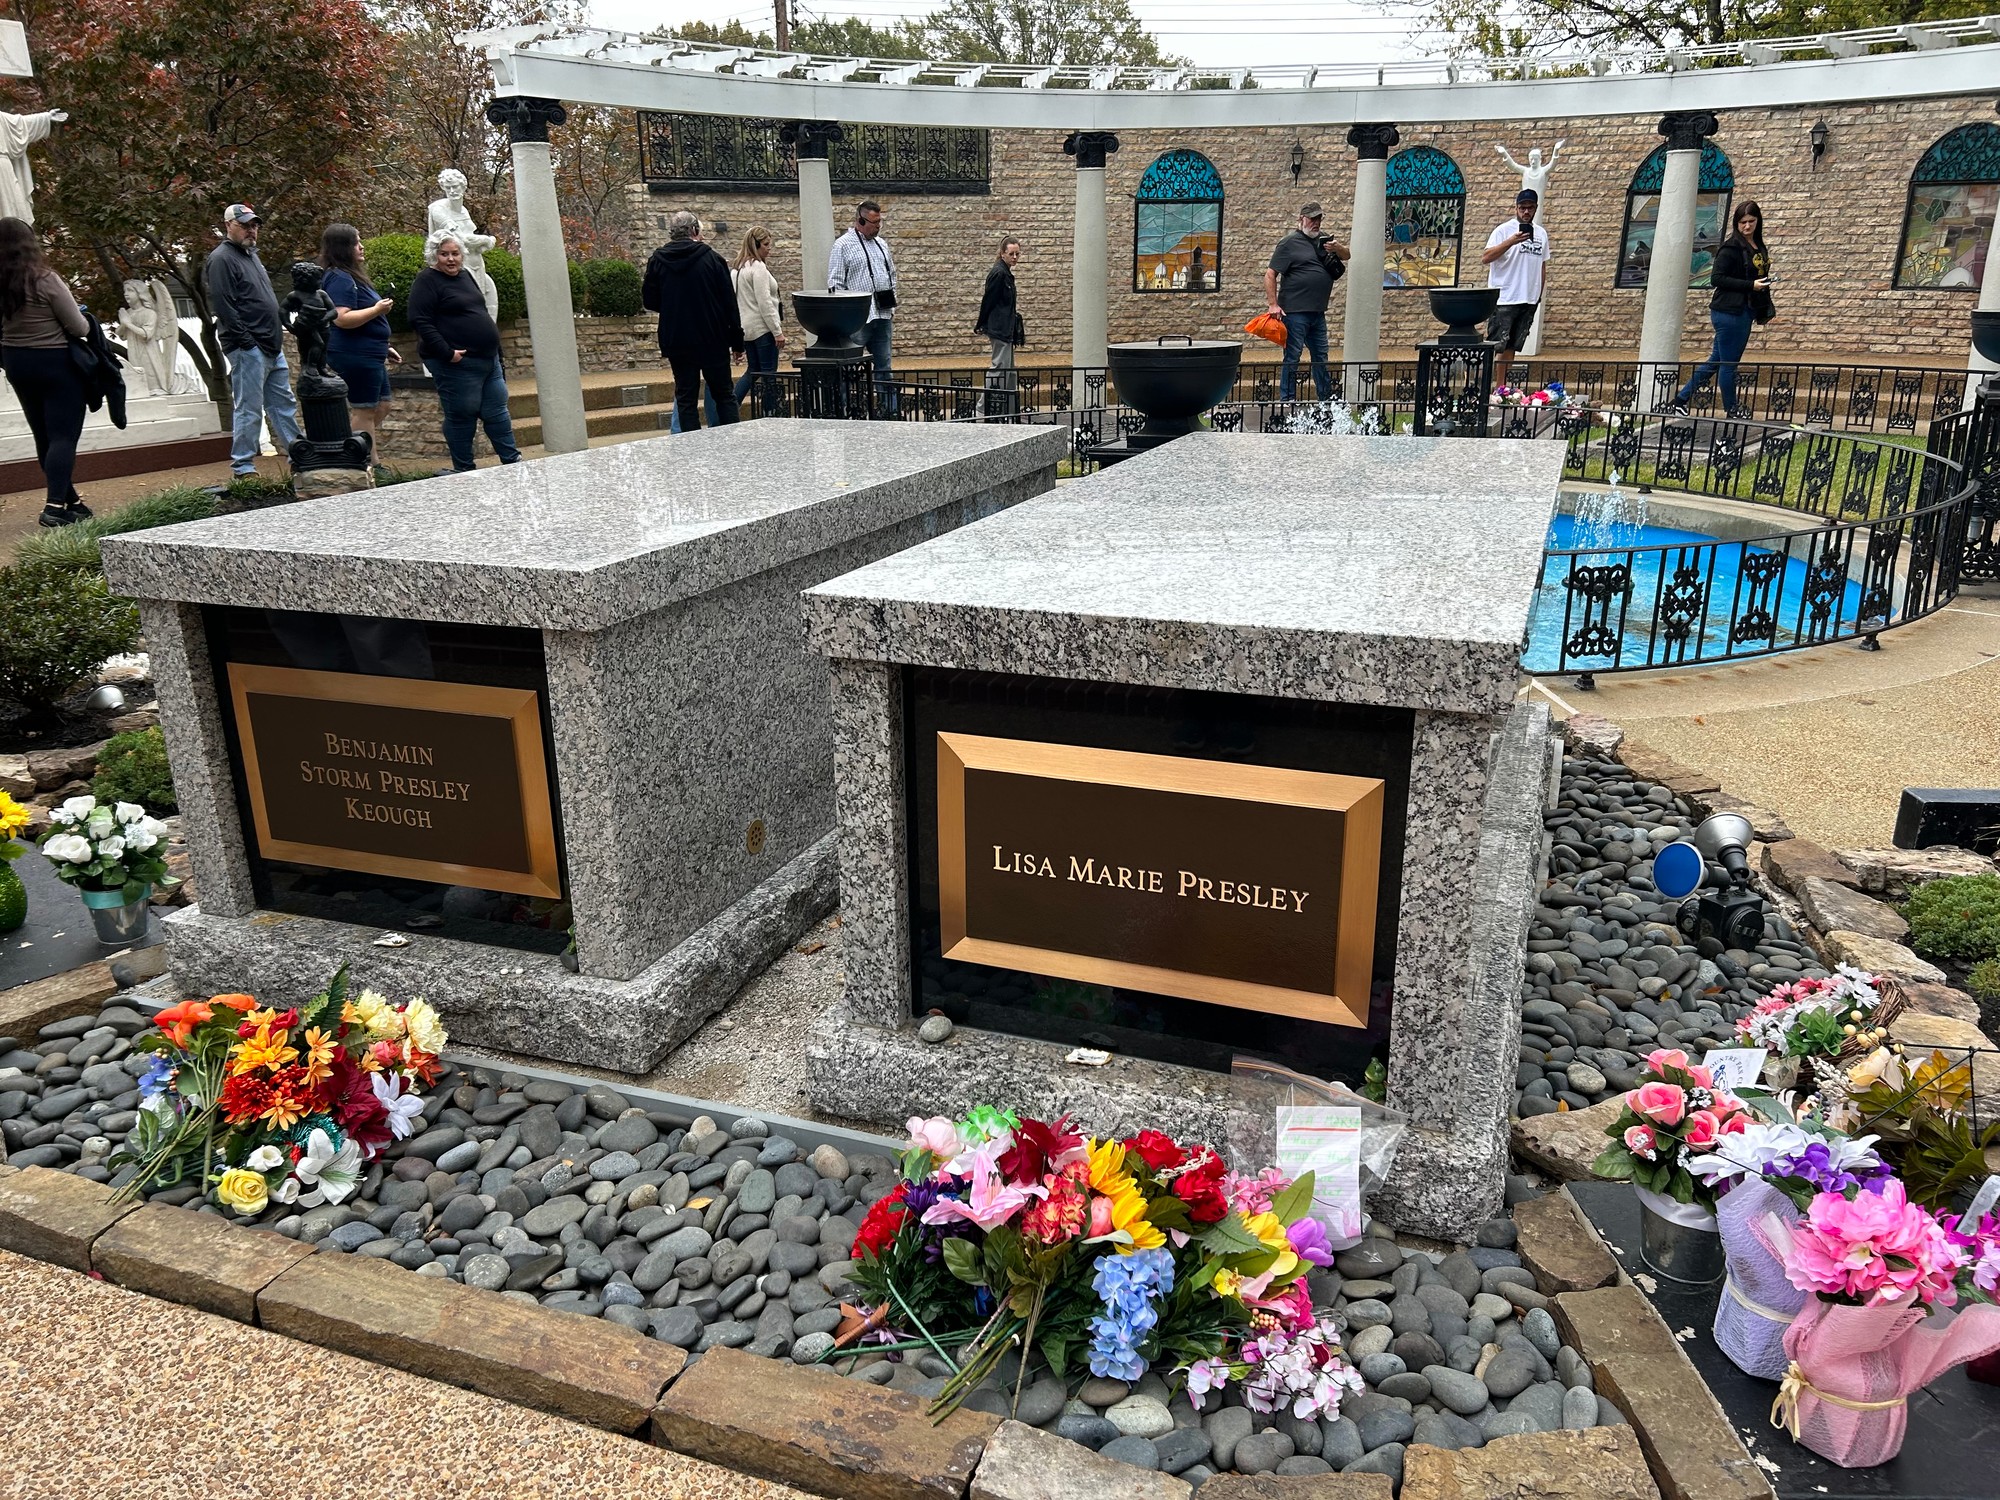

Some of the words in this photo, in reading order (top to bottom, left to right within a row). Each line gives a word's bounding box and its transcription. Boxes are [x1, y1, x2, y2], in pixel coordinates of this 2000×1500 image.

[324, 732, 433, 766] BENJAMIN
[300, 760, 372, 791] STORM
[379, 770, 471, 802] PRESLEY
[345, 797, 433, 829] KEOUGH
[993, 845, 1057, 879] LISA
[1066, 855, 1164, 894] MARIE
[1177, 870, 1310, 913] PRESLEY
[1710, 1056, 1738, 1068] OUNTRY
